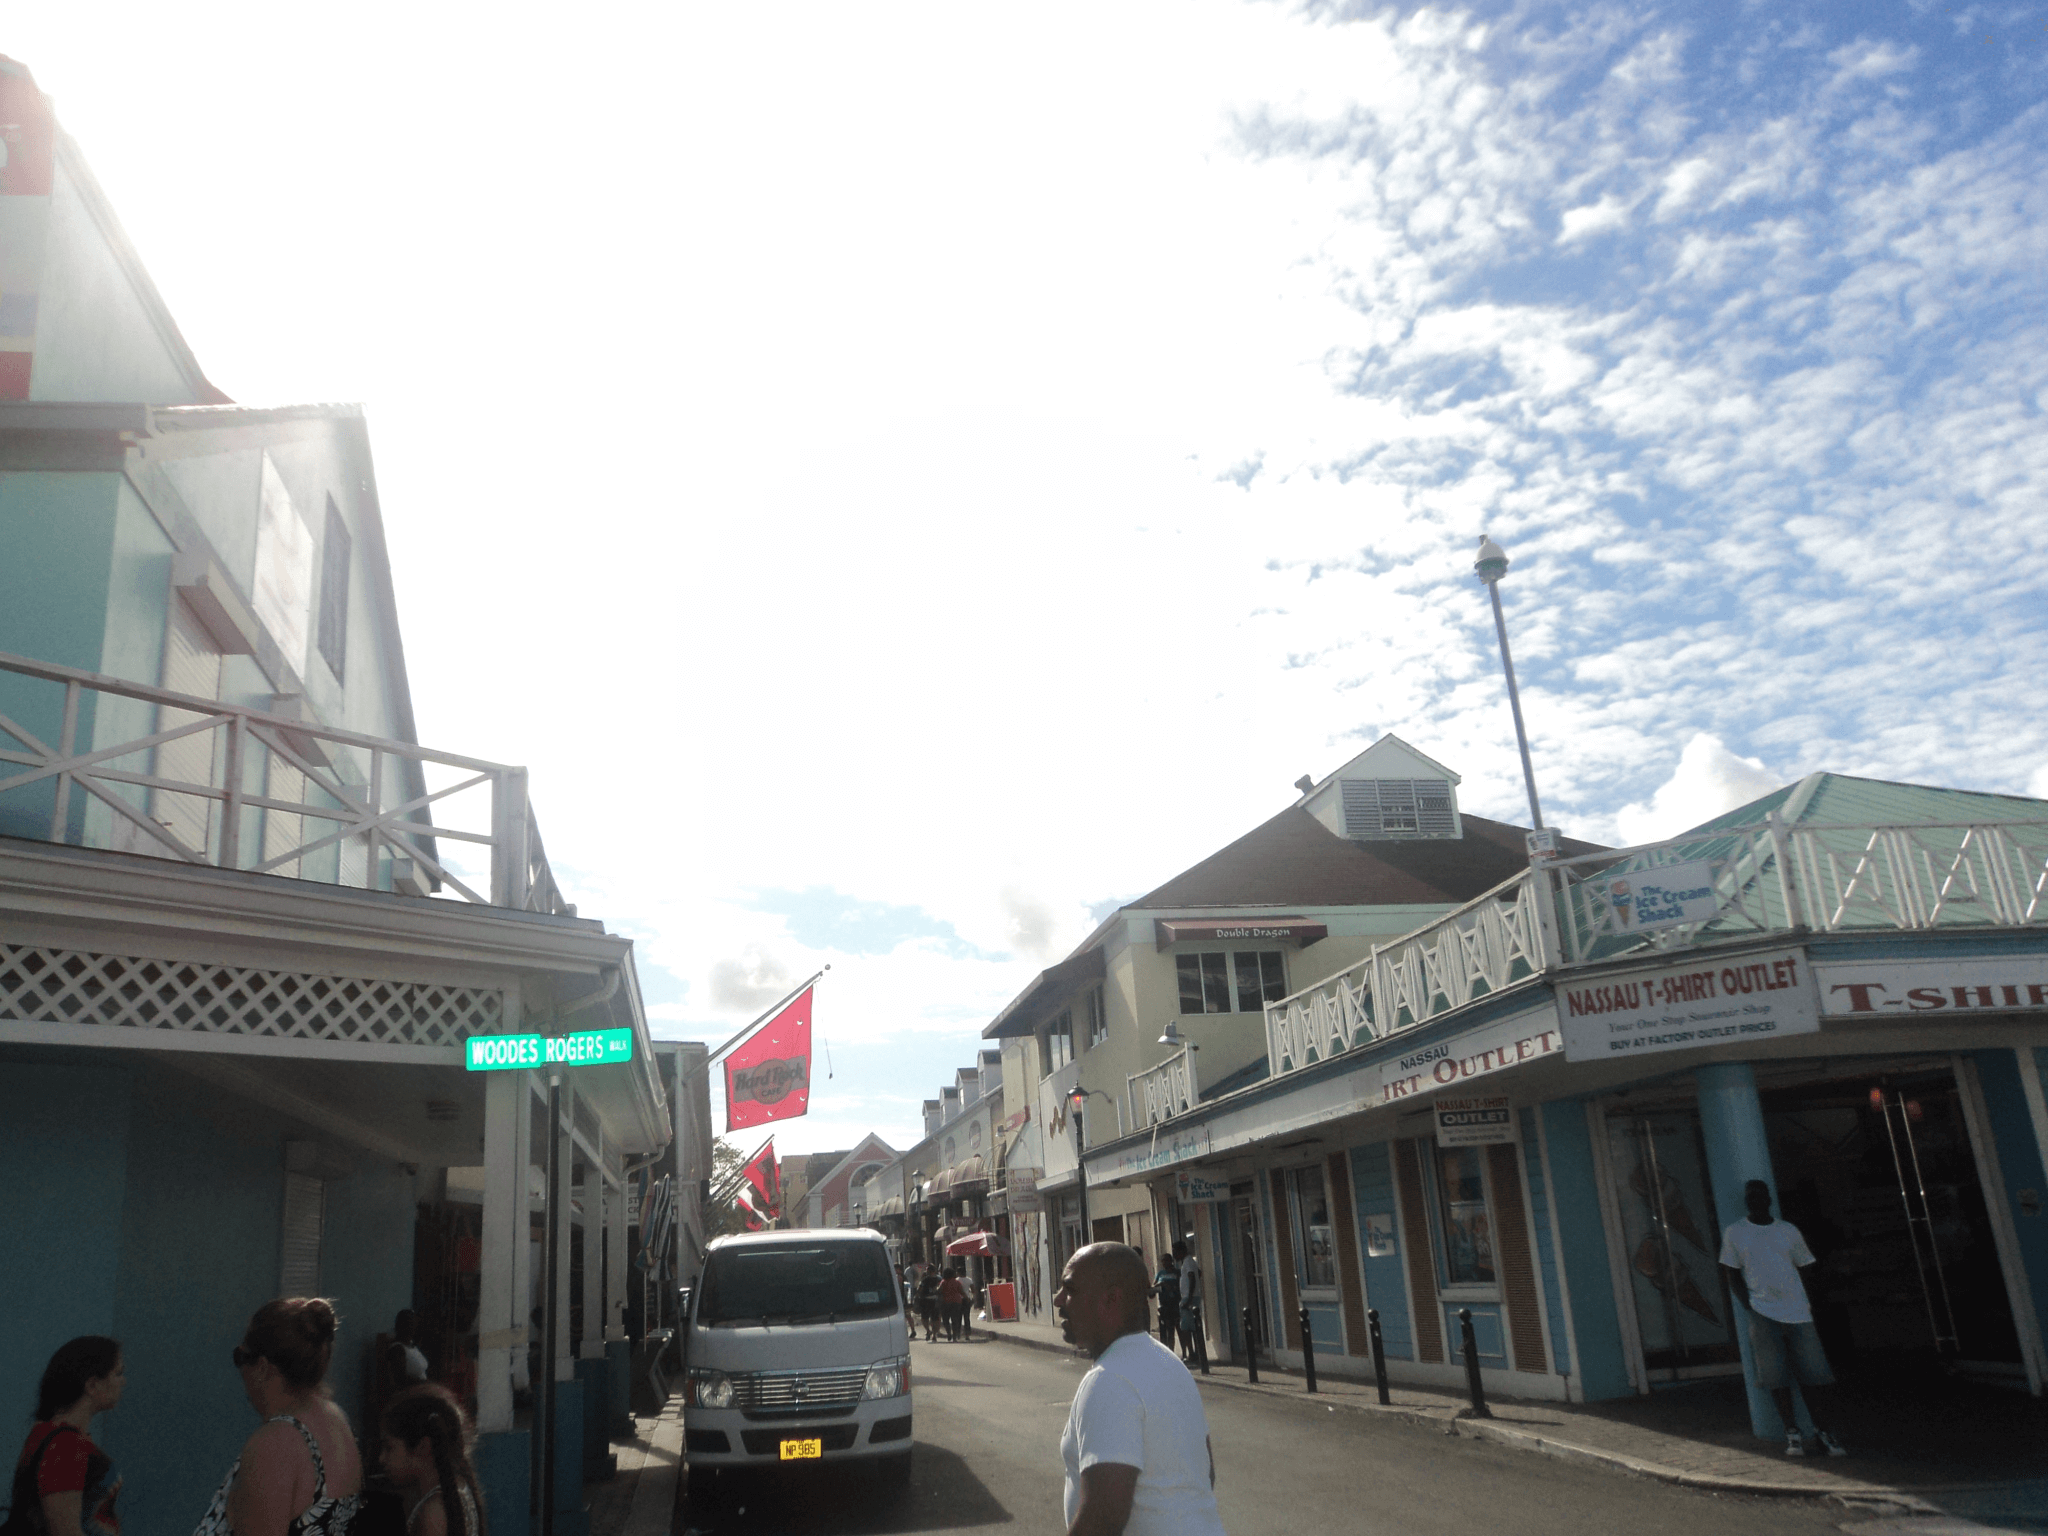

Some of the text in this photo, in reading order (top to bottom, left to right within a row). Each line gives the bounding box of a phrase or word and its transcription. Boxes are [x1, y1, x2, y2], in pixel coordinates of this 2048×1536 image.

[1635, 886, 1713, 909] Ice Cream
[1641, 885, 1661, 897] The
[1637, 903, 1684, 924] Shack
[1216, 928, 1291, 938] Double Dragon
[1566, 959, 1798, 1017] NASSAU T-SHIRT OUTLET
[1637, 1019, 1659, 1030] One
[1610, 1021, 1777, 1050] BUY AT FACTORY OUTLET PRICES
[472, 1034, 628, 1066] WOODES ROGERS WALK
[1400, 1045, 1449, 1071] NASSAU
[1433, 1030, 1556, 1084] OUTLET
[735, 1062, 805, 1092] Hard Rock
[761, 1086, 782, 1097] CAFE
[1435, 1096, 1509, 1111] NASSAU T-SHIRT
[1443, 1112, 1506, 1124] OUTLET
[1173, 1136, 1199, 1161] Shack
[1191, 1190, 1215, 1199] Shack
[1204, 1182, 1229, 1190] Cream
[785, 1444, 797, 1456] NP
